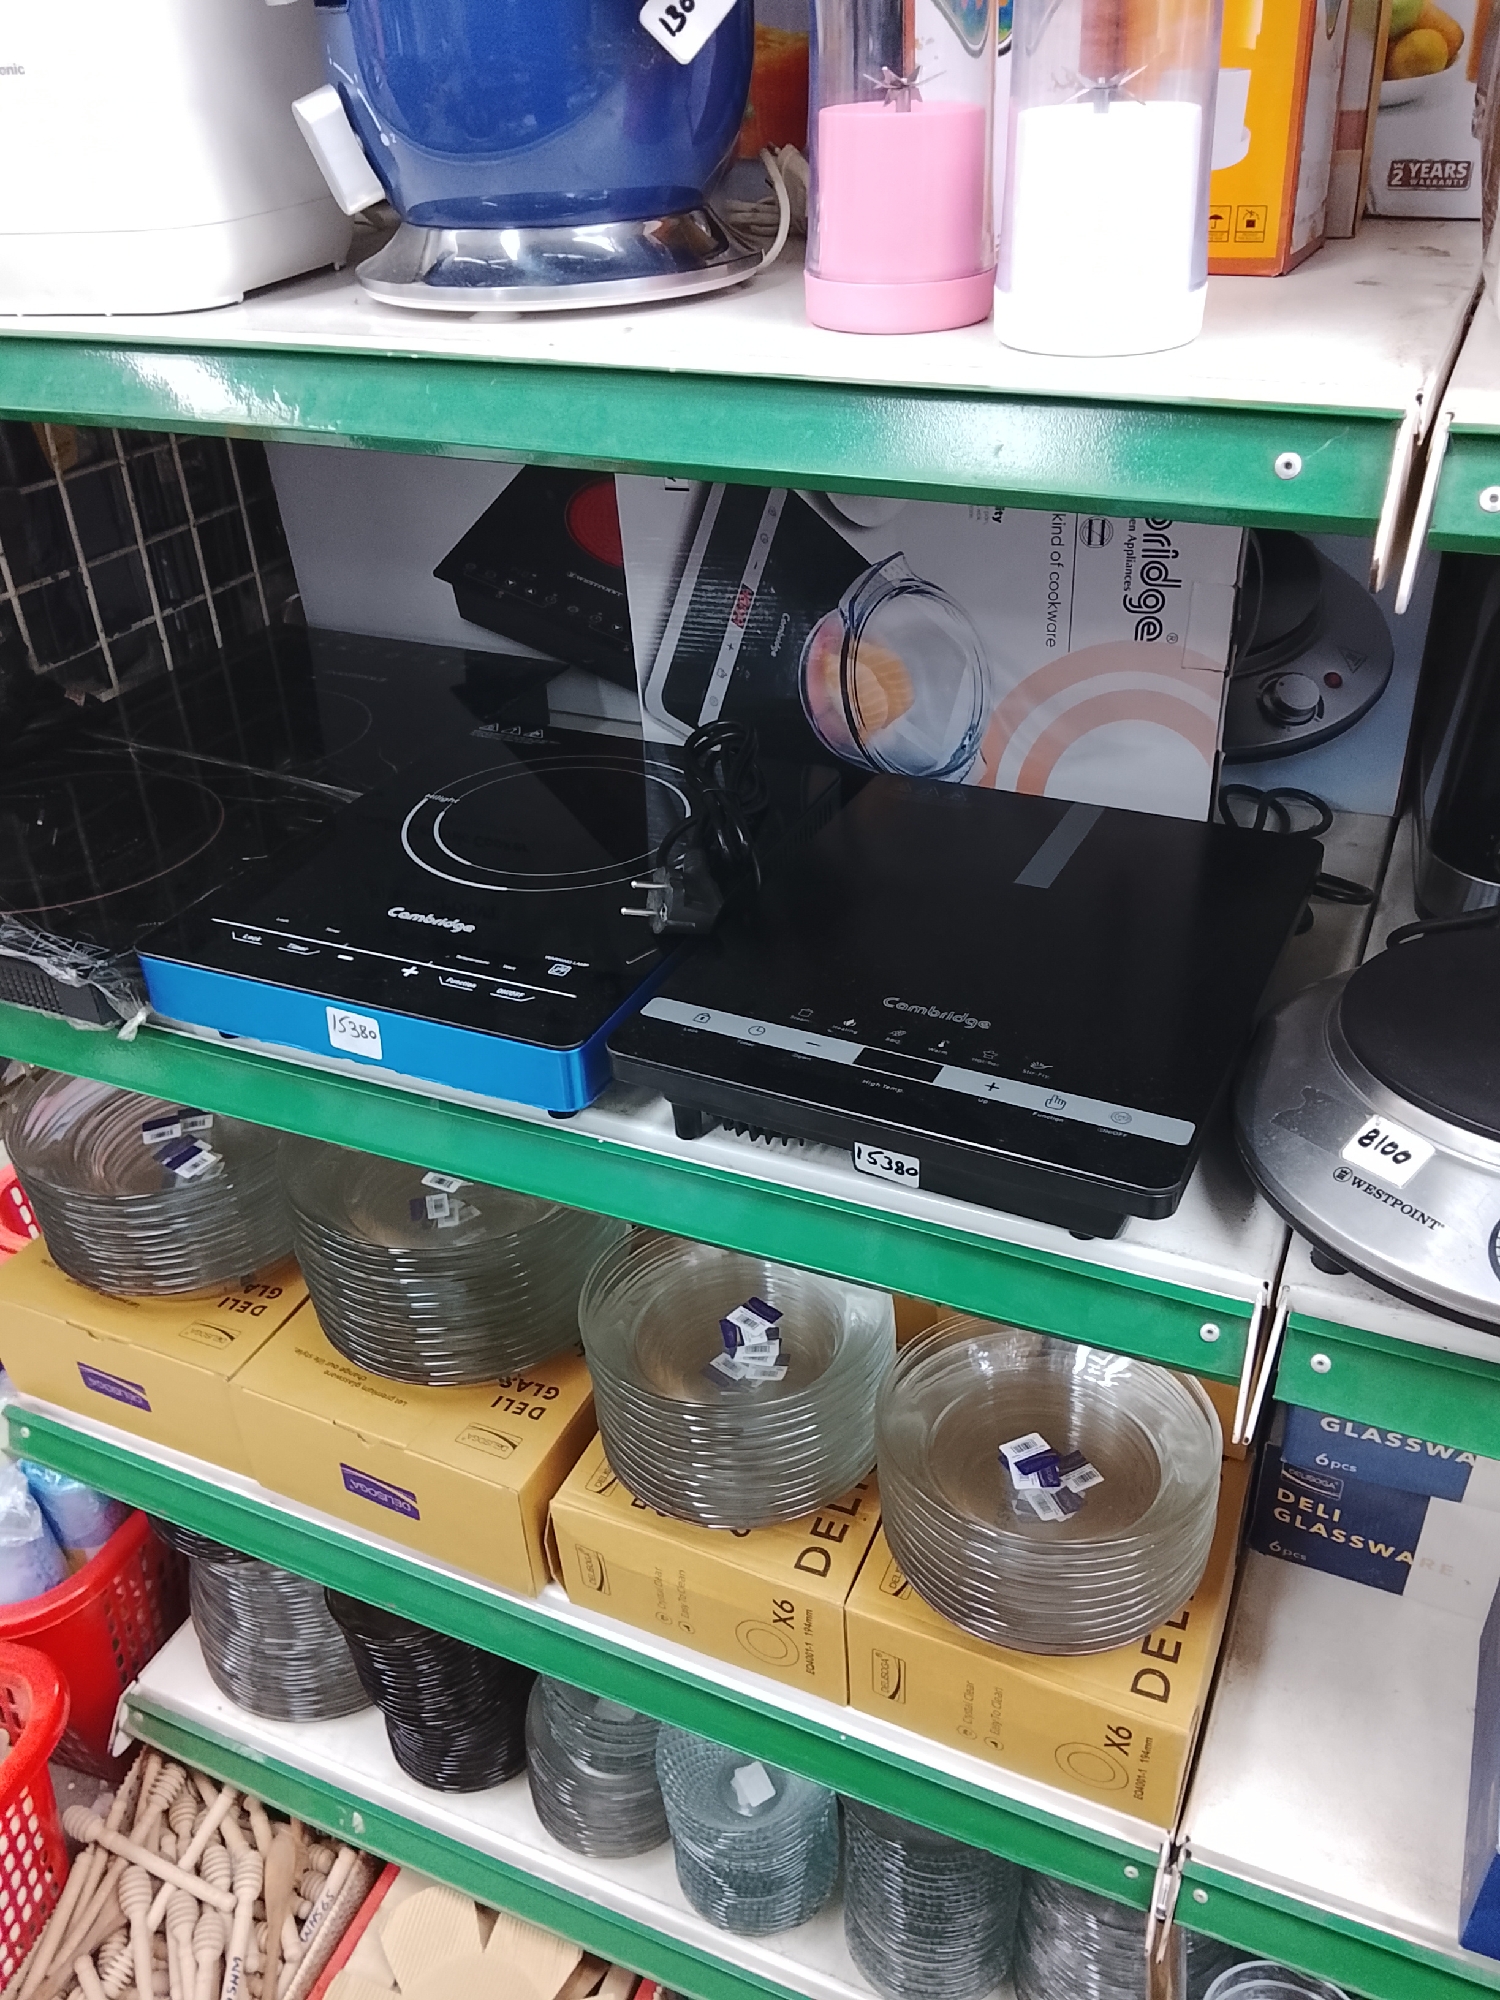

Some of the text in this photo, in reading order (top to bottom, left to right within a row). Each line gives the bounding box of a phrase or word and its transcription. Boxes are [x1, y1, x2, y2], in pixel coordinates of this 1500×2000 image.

[1391, 162, 1469, 185] 2 YEARS
[1123, 534, 1138, 592] Appliances
[1045, 513, 1067, 648] kind of cookware
[387, 906, 476, 933] Cambridge
[332, 1013, 378, 1040] 15380
[882, 996, 992, 1030] Cambridge
[1031, 1111, 1065, 1123] Function
[856, 1145, 919, 1177] 15380
[1357, 1128, 1412, 1164] 8100
[1350, 1175, 1442, 1230] WESTPOINT
[218, 1297, 268, 1317] DELI
[490, 1395, 548, 1420] DELI
[1277, 1487, 1342, 1522] DELI
[772, 1598, 795, 1630] X6
[1130, 1595, 1195, 1703] DEL
[1104, 1724, 1133, 1757] X6
